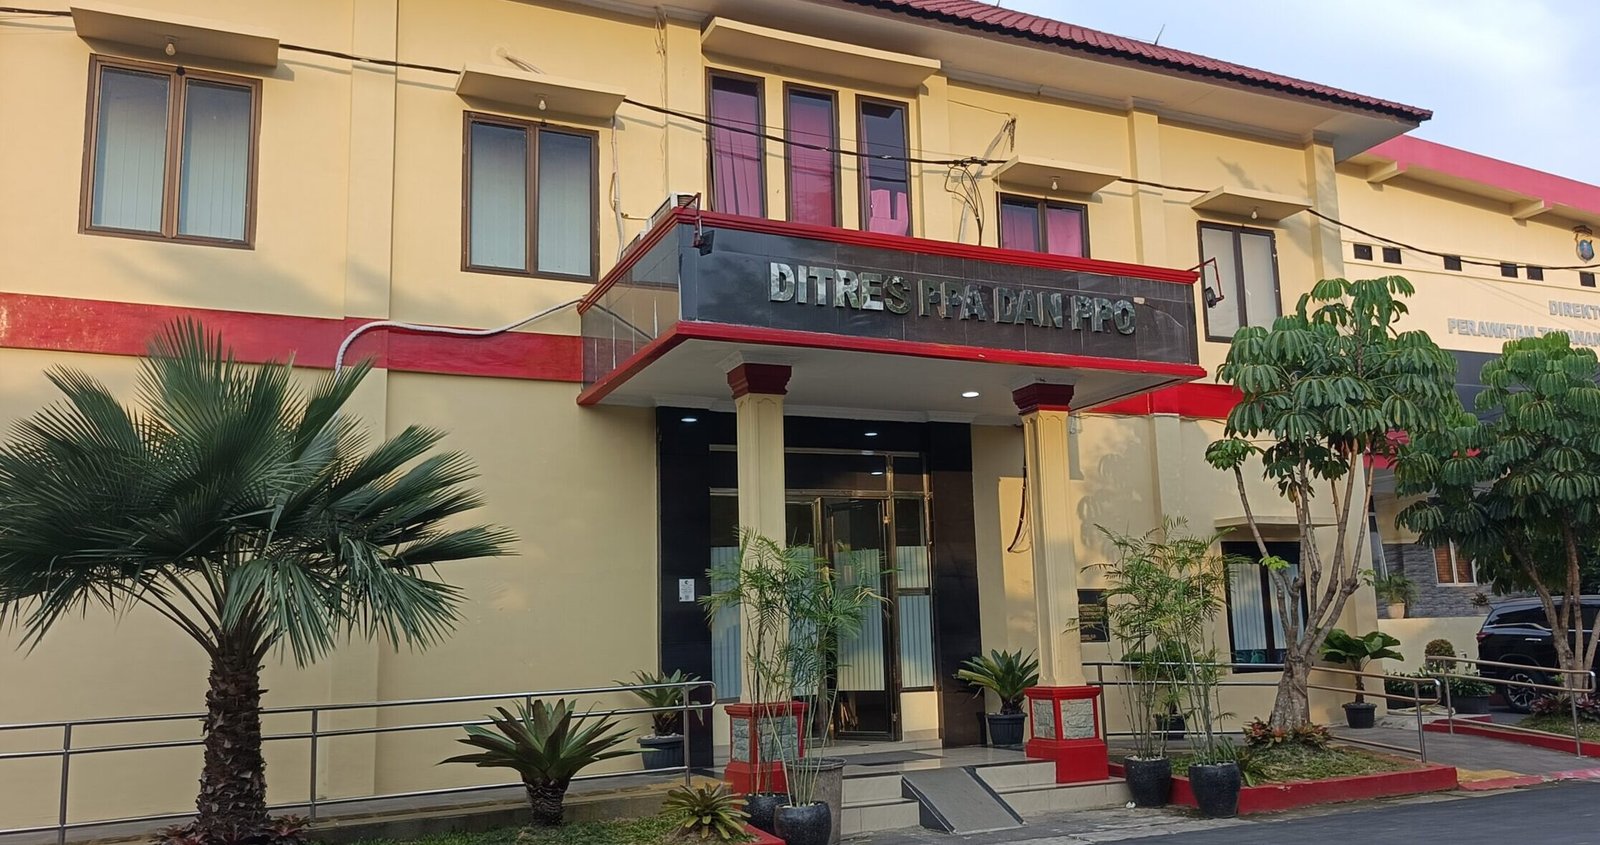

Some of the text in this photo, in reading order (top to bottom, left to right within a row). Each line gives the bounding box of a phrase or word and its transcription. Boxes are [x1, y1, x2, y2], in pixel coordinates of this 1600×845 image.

[769, 262, 1136, 335] DITRES PPA DAN PPO
[1548, 300, 1600, 320] DIREKT
[1447, 318, 1535, 339] PERAWATAN
